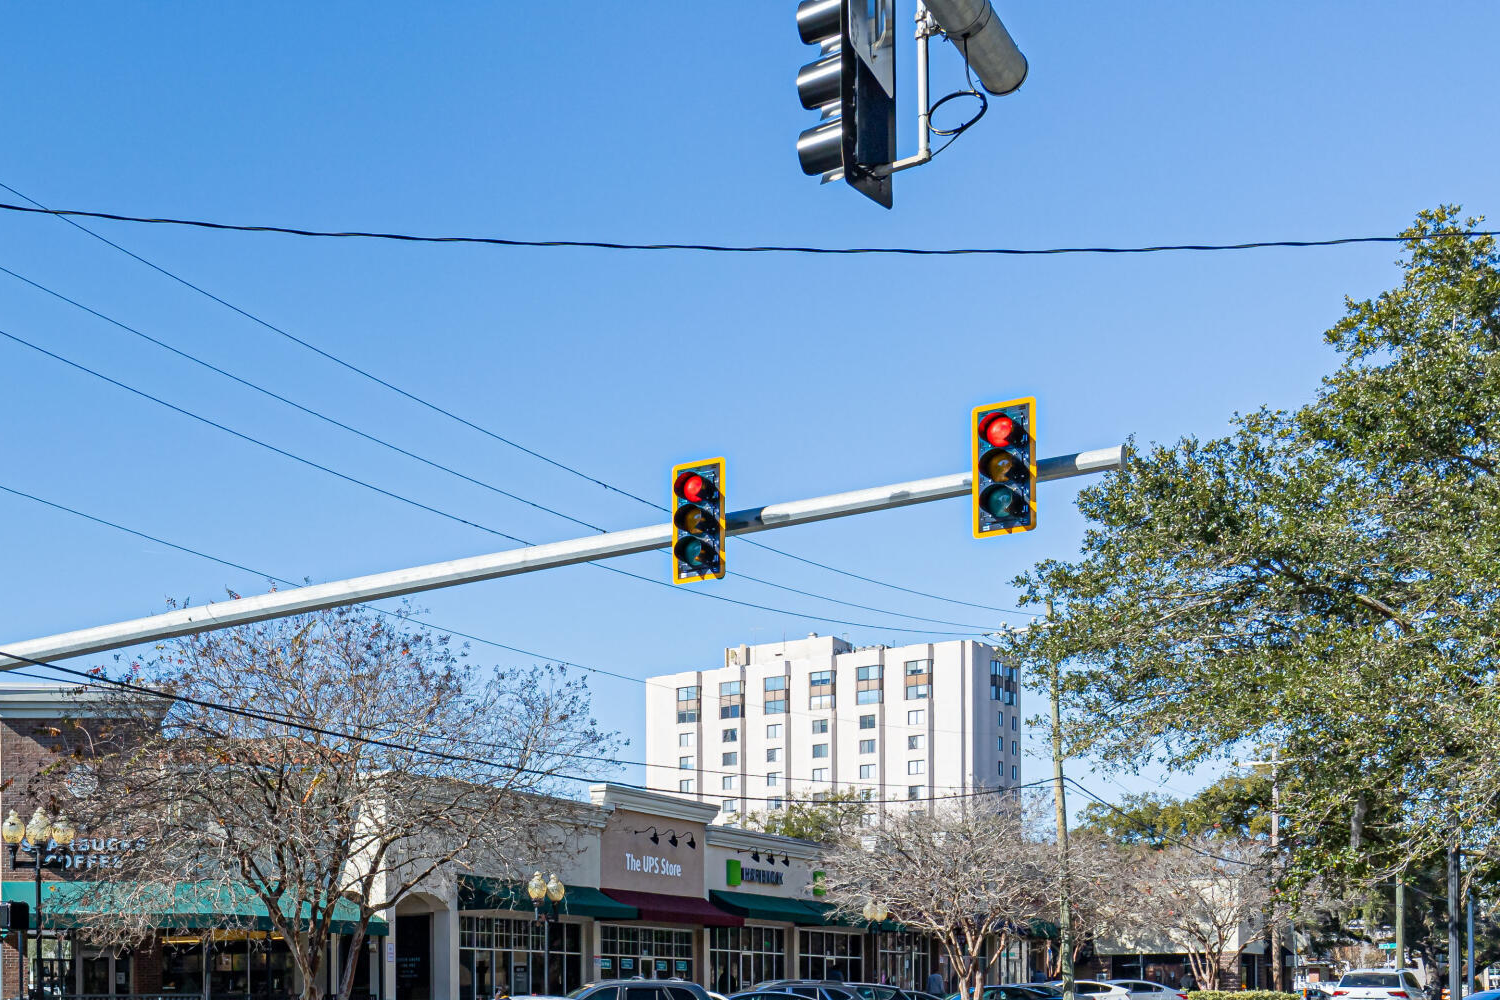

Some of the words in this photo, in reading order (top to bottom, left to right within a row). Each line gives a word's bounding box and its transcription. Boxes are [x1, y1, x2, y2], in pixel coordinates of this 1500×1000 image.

[625, 852, 641, 872] The
[643, 855, 660, 874] UPS
[661, 857, 682, 877] Store
